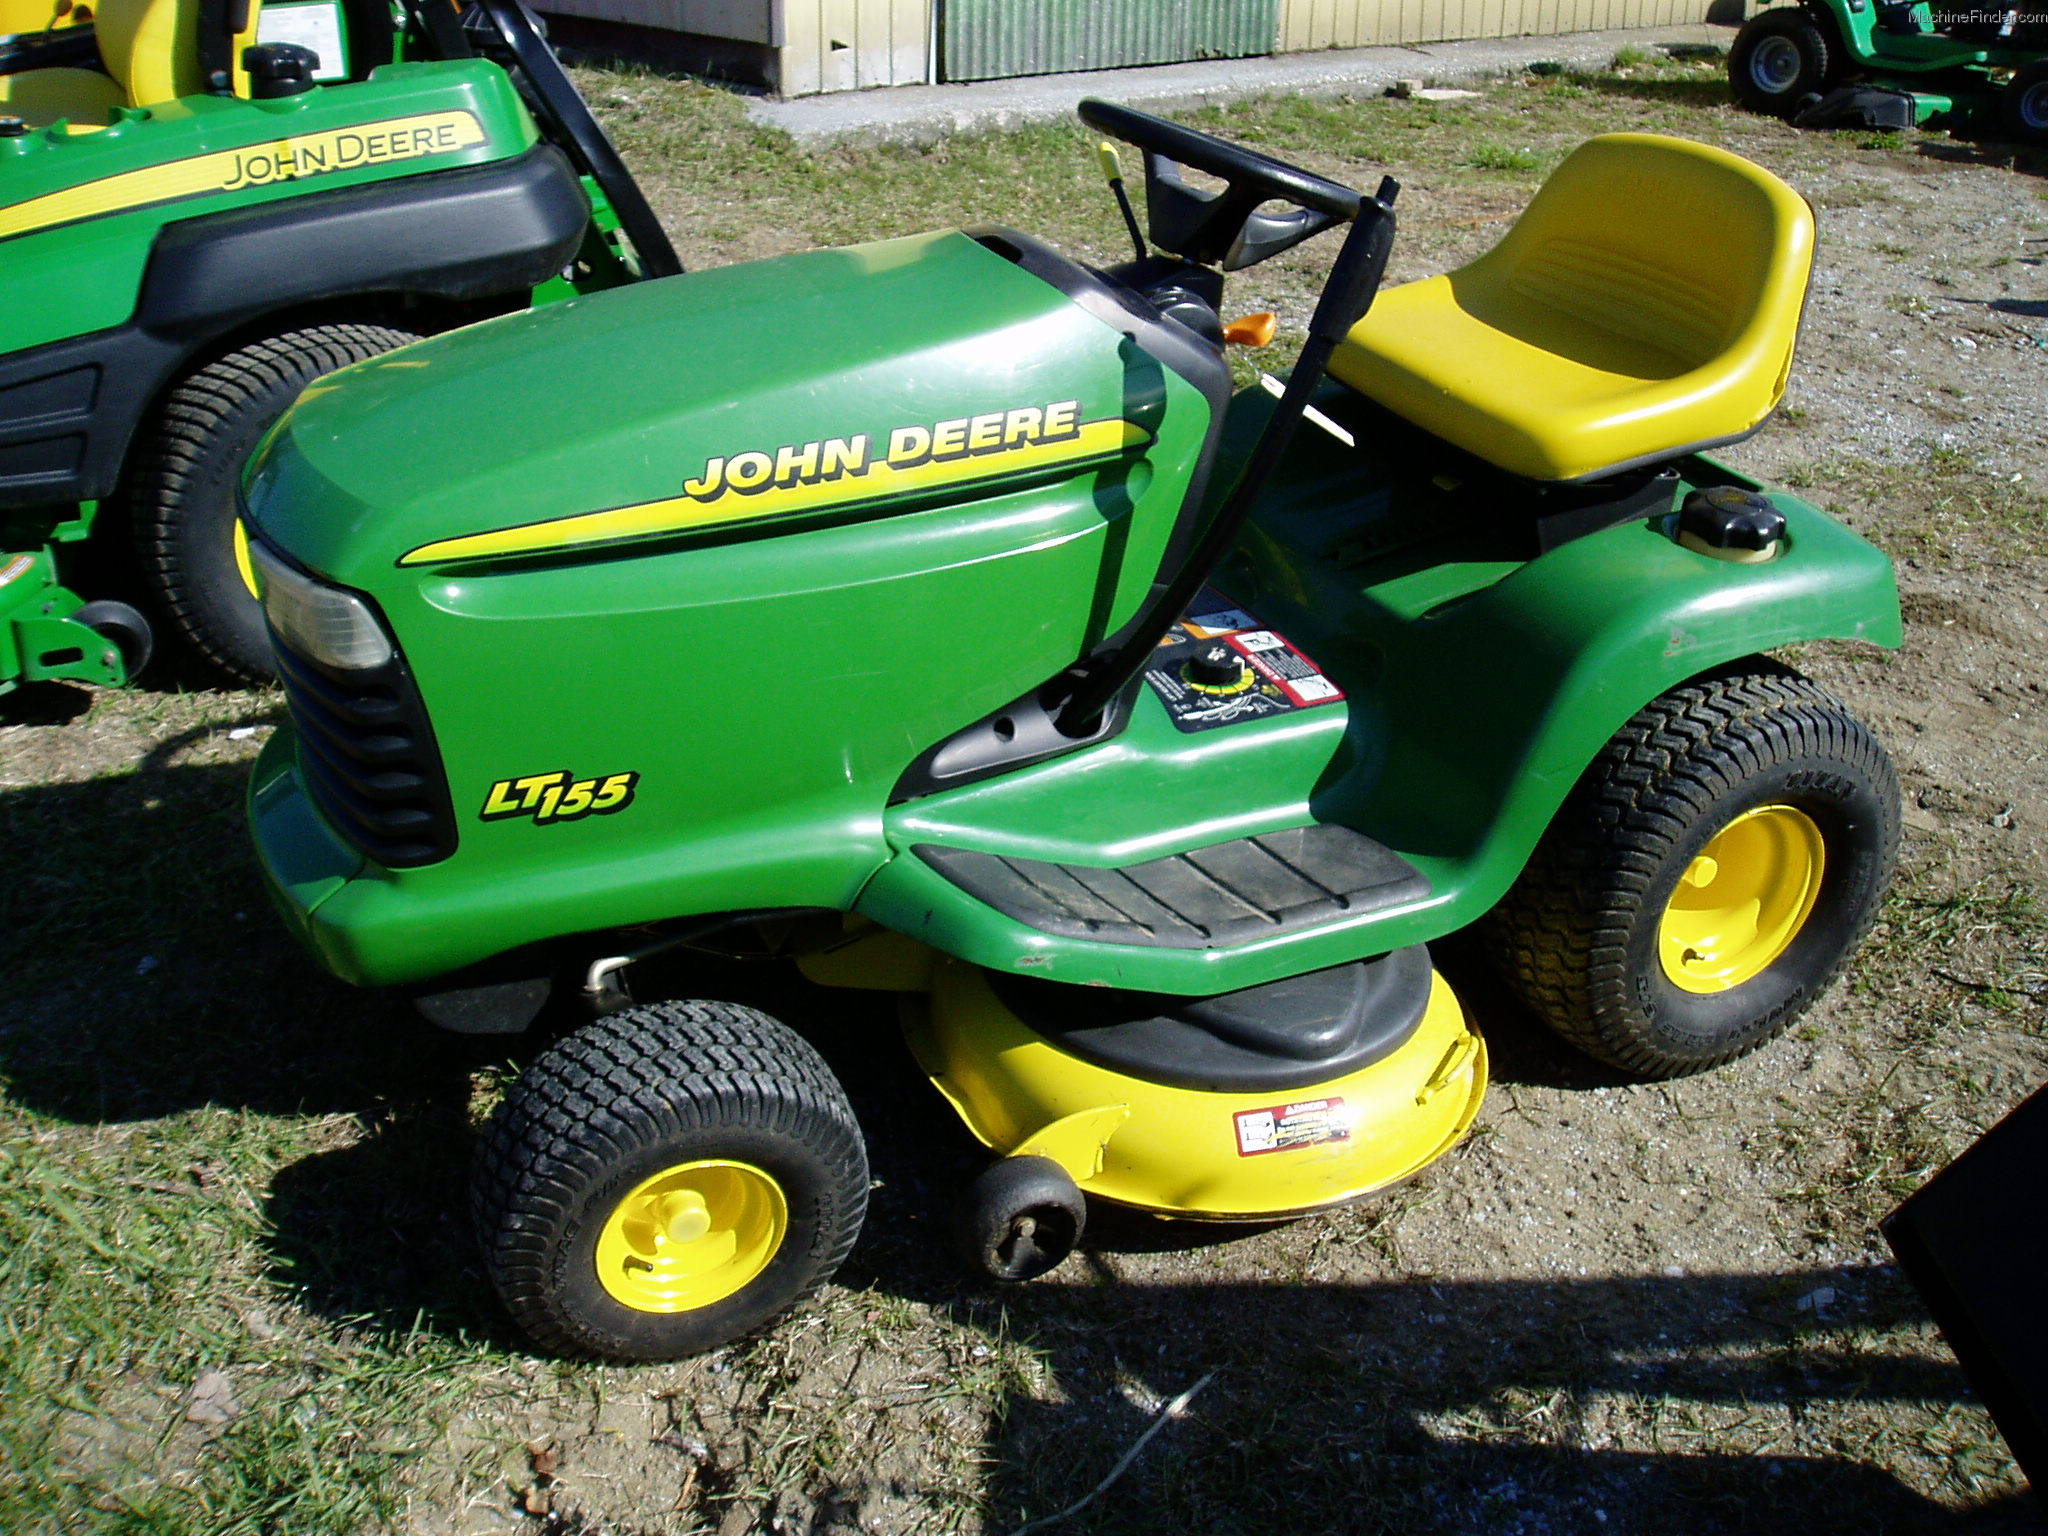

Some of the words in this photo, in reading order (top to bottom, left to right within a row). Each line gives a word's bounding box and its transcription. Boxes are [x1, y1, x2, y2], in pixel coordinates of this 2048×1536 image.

[224, 144, 326, 186] JOHN
[336, 123, 457, 164] DEERE
[683, 433, 872, 503] JOHN
[887, 399, 1082, 470] DEERE
[478, 769, 640, 827] LT155
